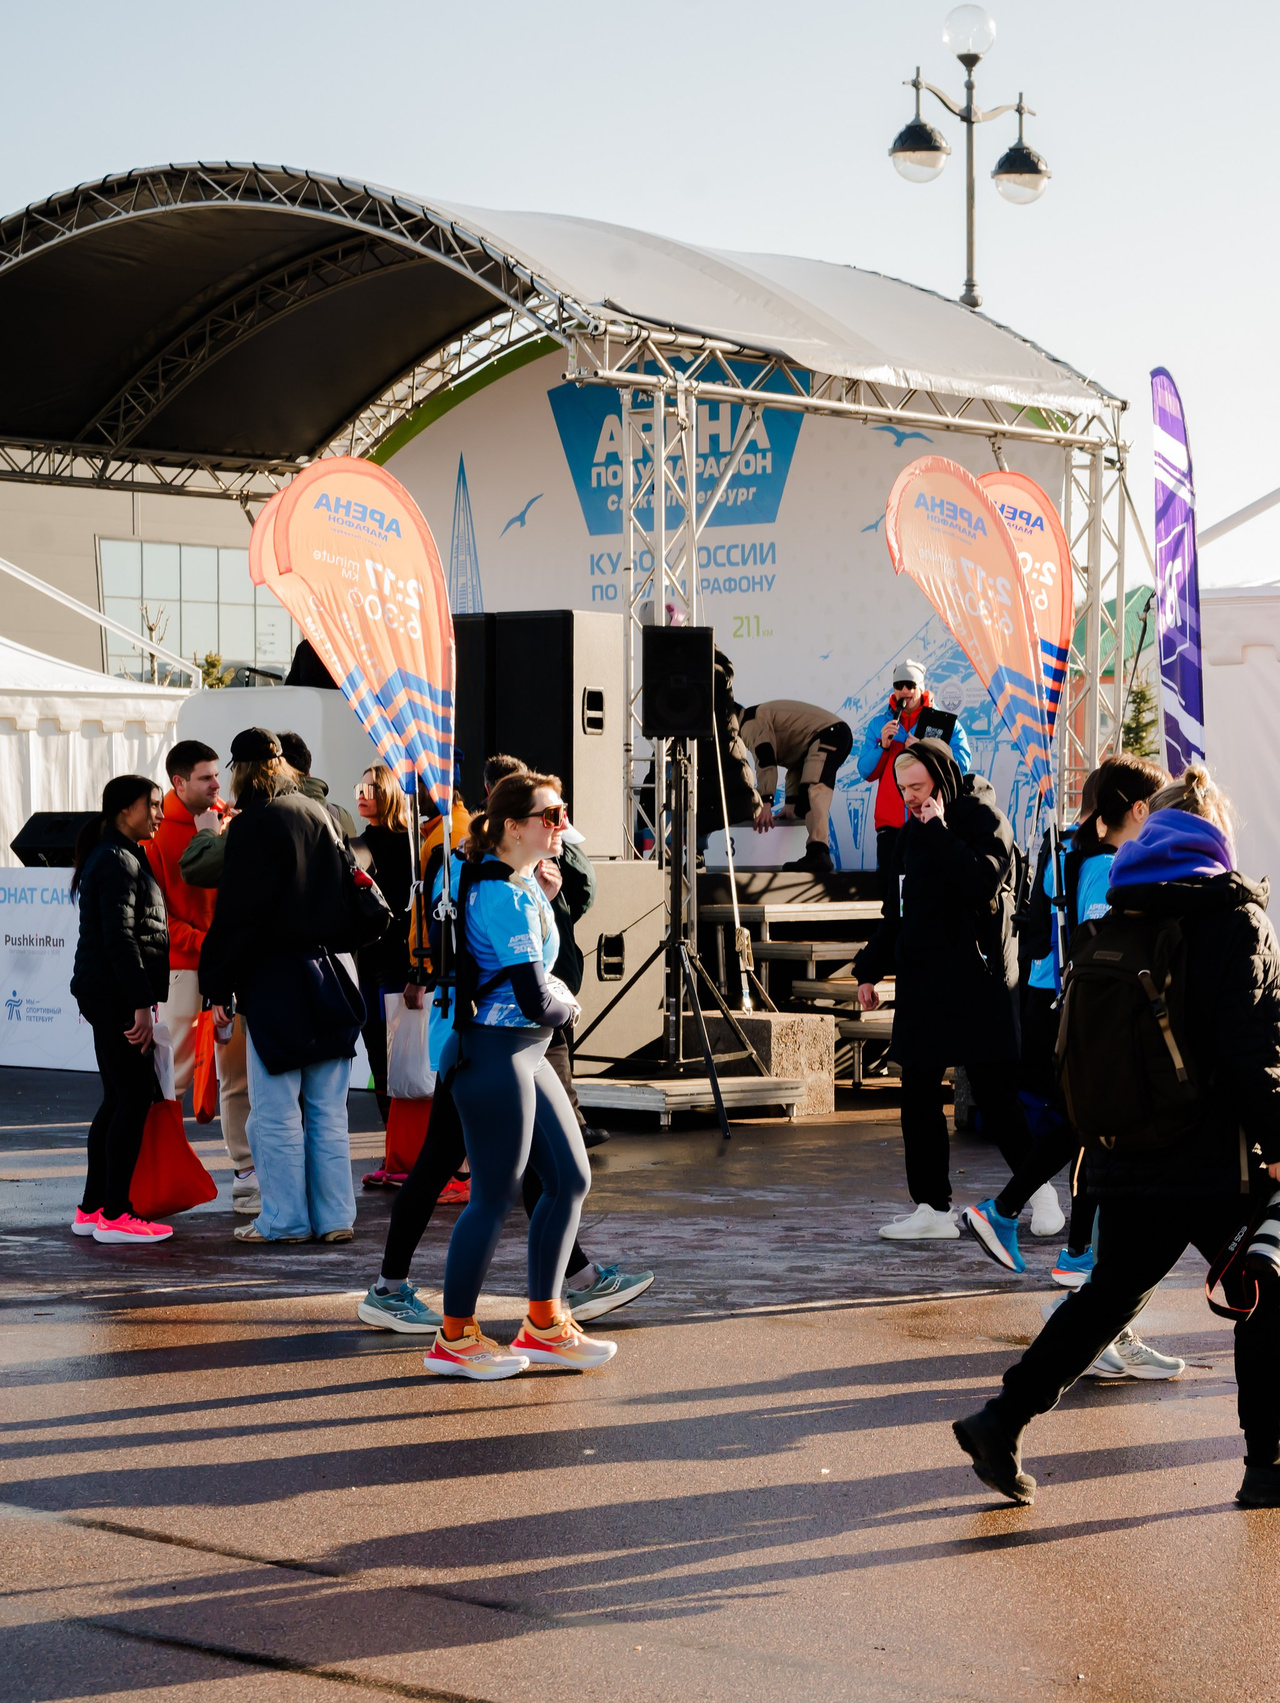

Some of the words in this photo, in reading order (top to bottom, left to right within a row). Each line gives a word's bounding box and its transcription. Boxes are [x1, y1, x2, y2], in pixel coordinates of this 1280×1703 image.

[683, 541, 776, 571] ОССИИ
[592, 584, 618, 601] ПО
[4, 933, 65, 947] PushkinRun
[26, 1007, 61, 1015] СПОРТИВНЫЙ
[26, 1015, 54, 1023] ПЕТЕРБУРГ
